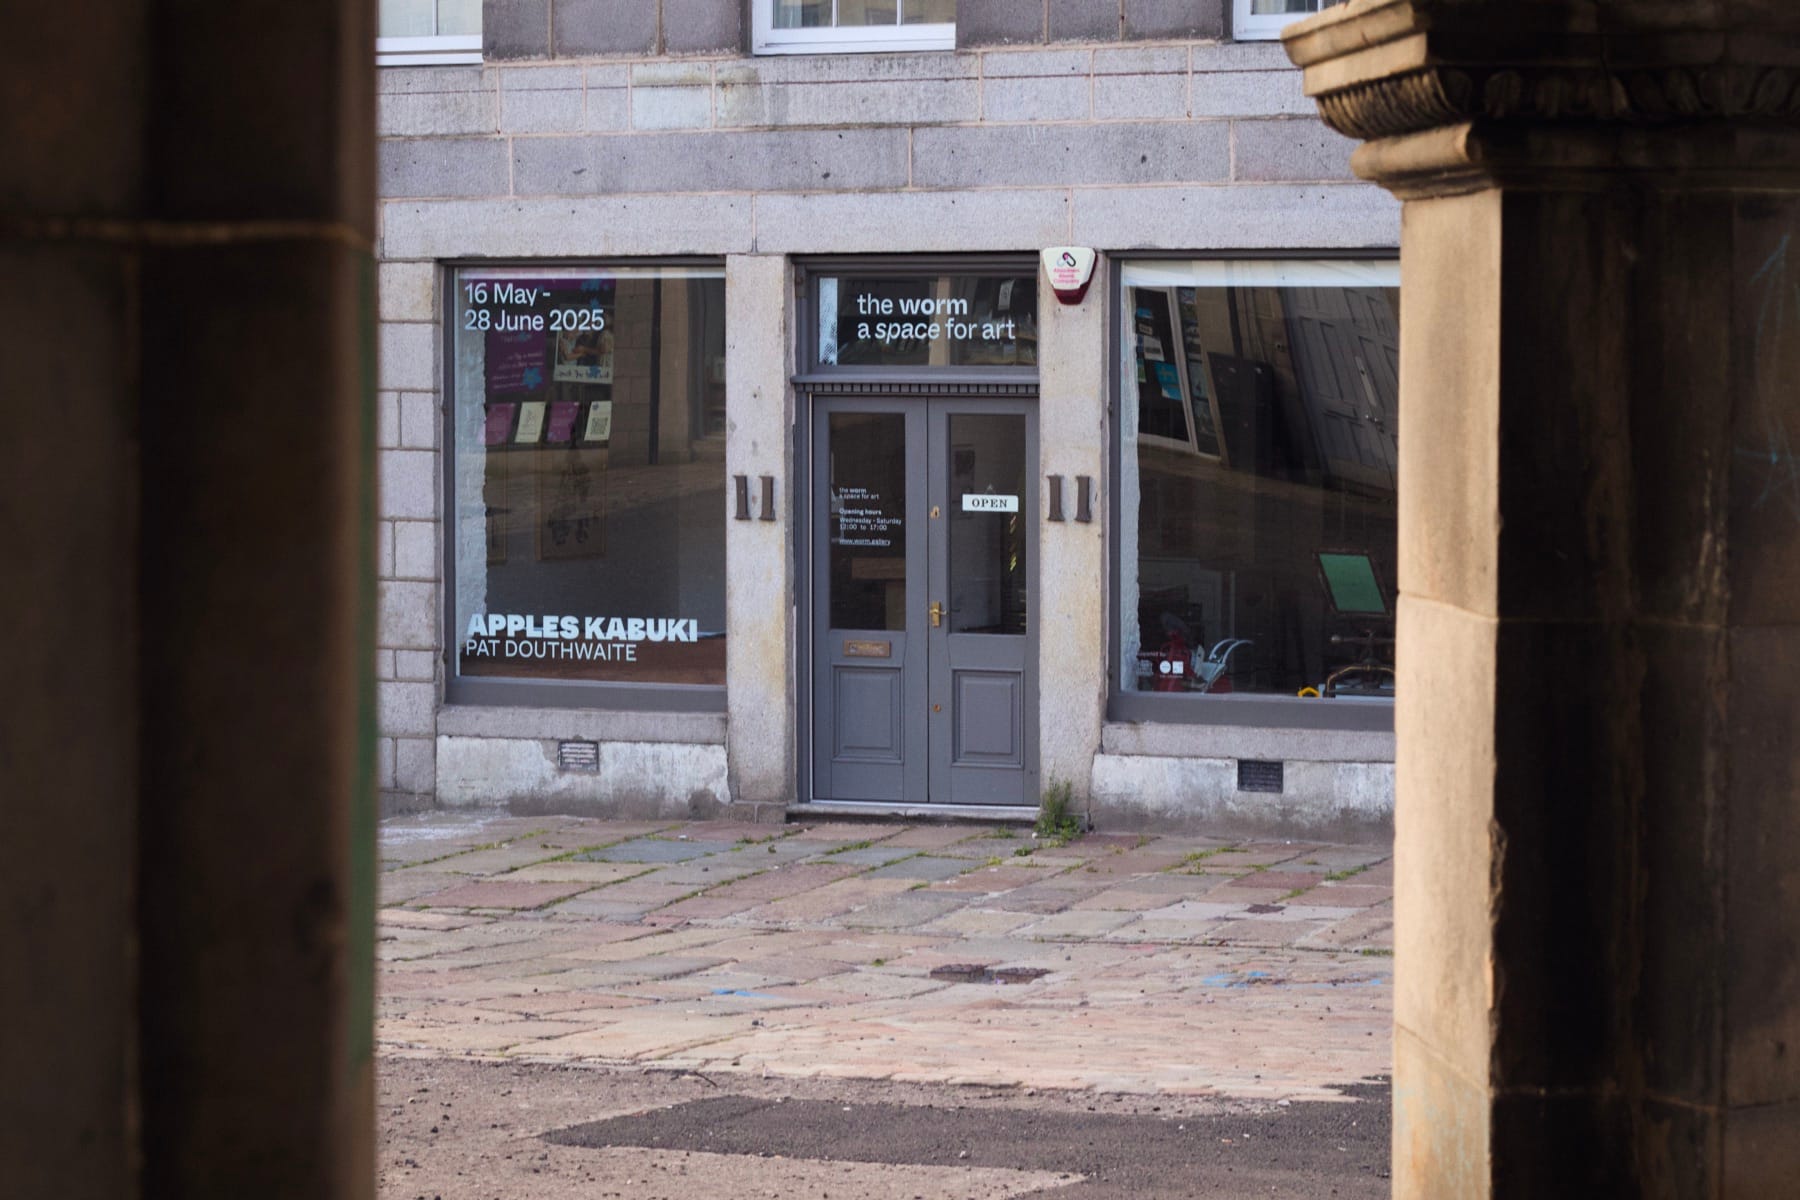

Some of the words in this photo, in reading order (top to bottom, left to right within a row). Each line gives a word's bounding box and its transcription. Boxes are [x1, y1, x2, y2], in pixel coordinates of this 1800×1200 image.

[464, 282, 488, 304] 16
[494, 283, 537, 306] May
[857, 293, 893, 315] the
[898, 298, 968, 315] worm
[464, 309, 491, 331] 28
[494, 309, 544, 331] June
[549, 309, 605, 331] 2025
[857, 322, 871, 339] a
[875, 322, 940, 344] space
[945, 318, 977, 339] for
[982, 319, 1016, 340] art
[839, 508, 864, 516] Opening
[971, 497, 1008, 508] OPEN
[876, 517, 902, 525] Saturday
[467, 613, 580, 639] APPLES
[584, 617, 698, 642] KABUKI
[466, 639, 500, 657] PAT
[505, 640, 637, 661] DOUTHWAITE
